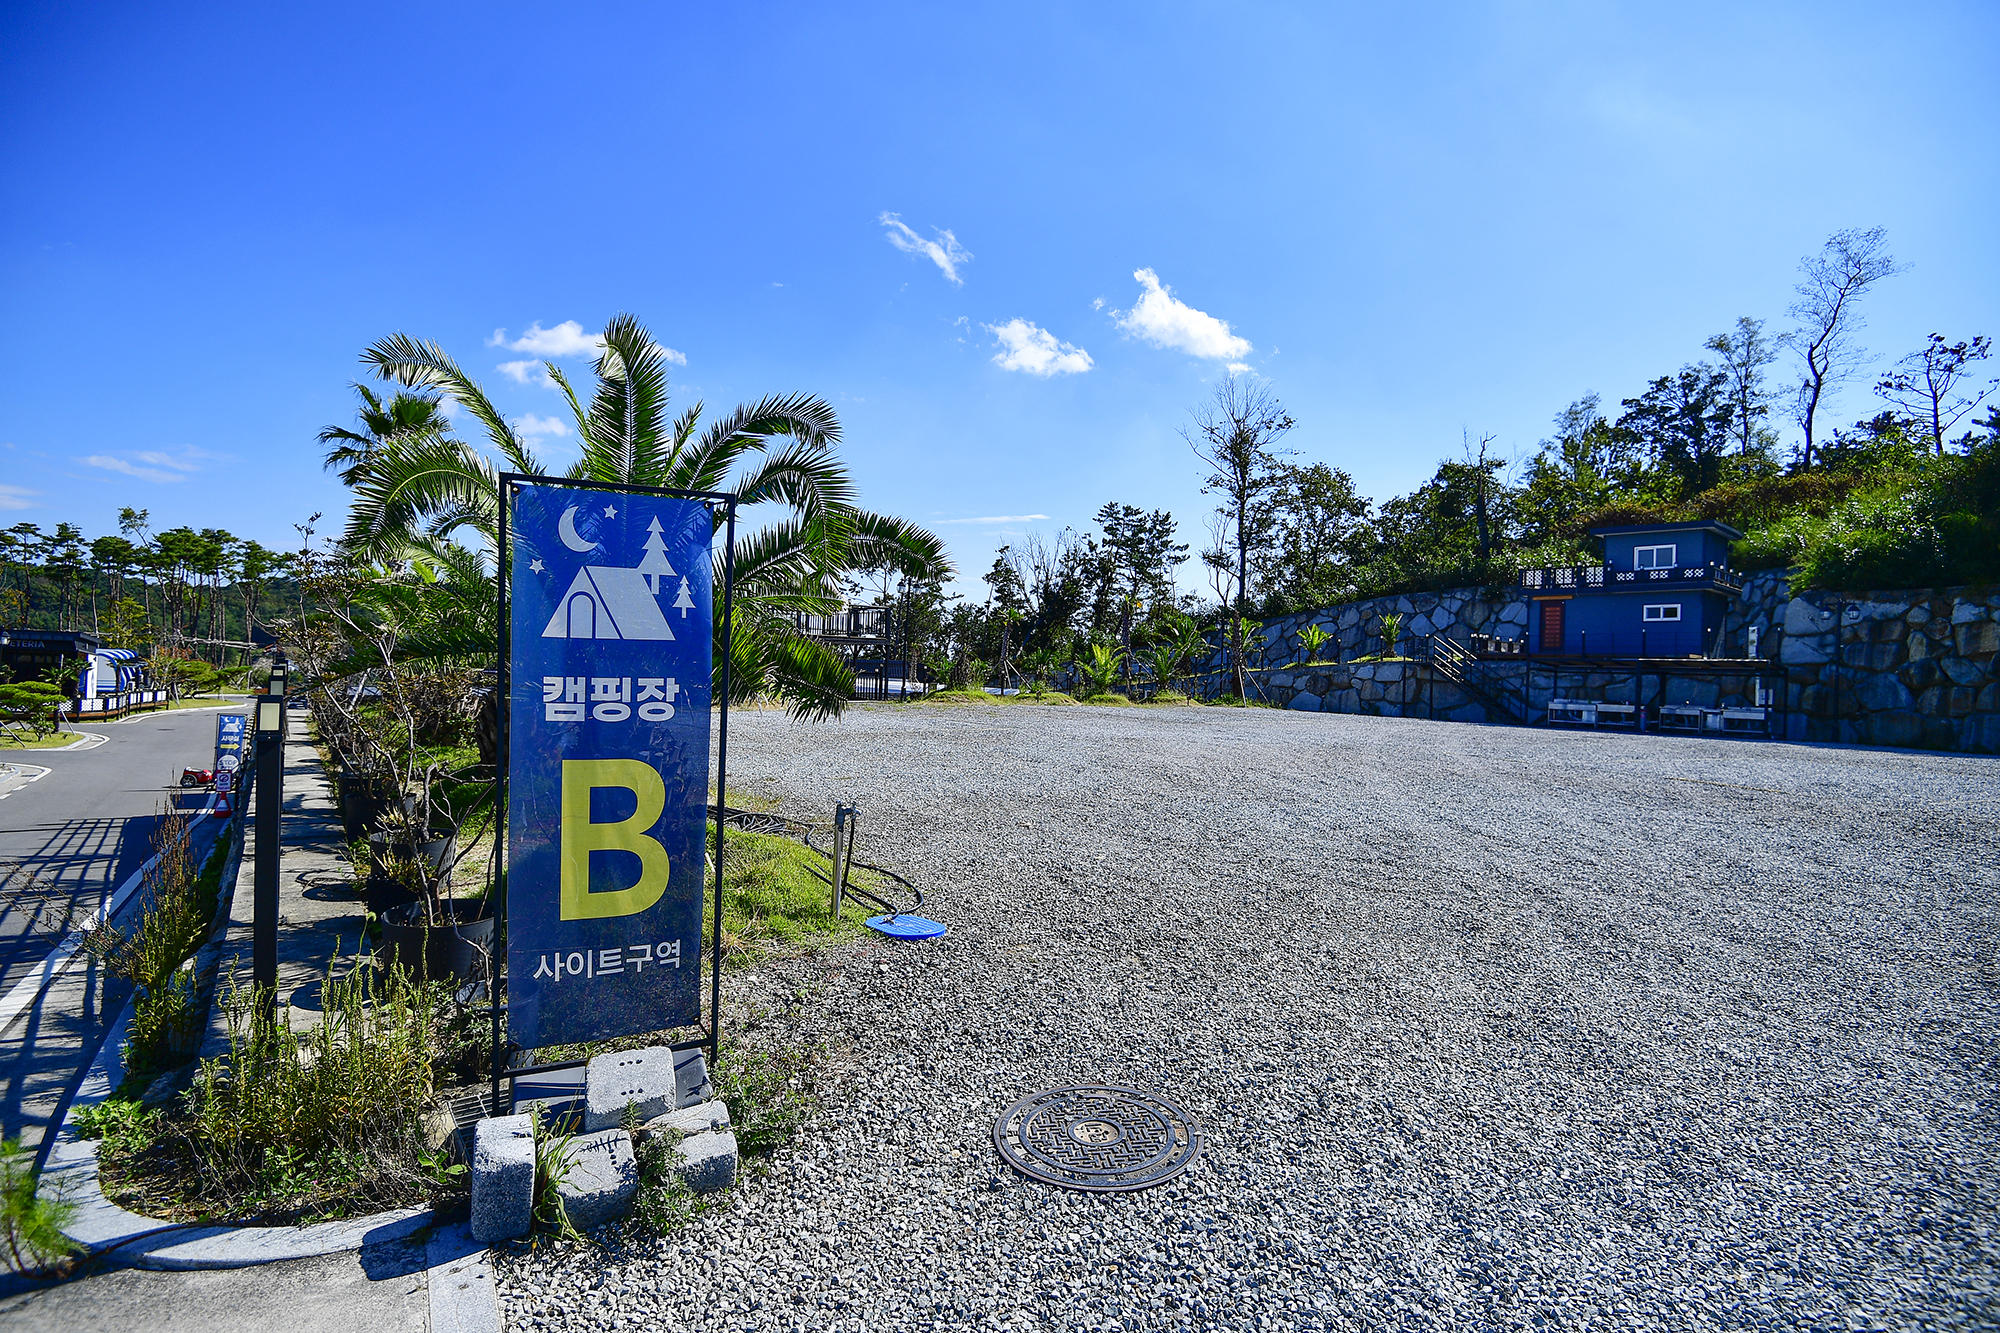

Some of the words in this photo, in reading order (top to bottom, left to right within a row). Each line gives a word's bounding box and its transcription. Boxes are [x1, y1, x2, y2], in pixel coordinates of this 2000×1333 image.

[9, 640, 45, 648] ETERIA
[542, 676, 680, 722] 캠핑장
[219, 759, 238, 767] STOP
[560, 758, 670, 921] B
[533, 939, 681, 982] 사이트구역
